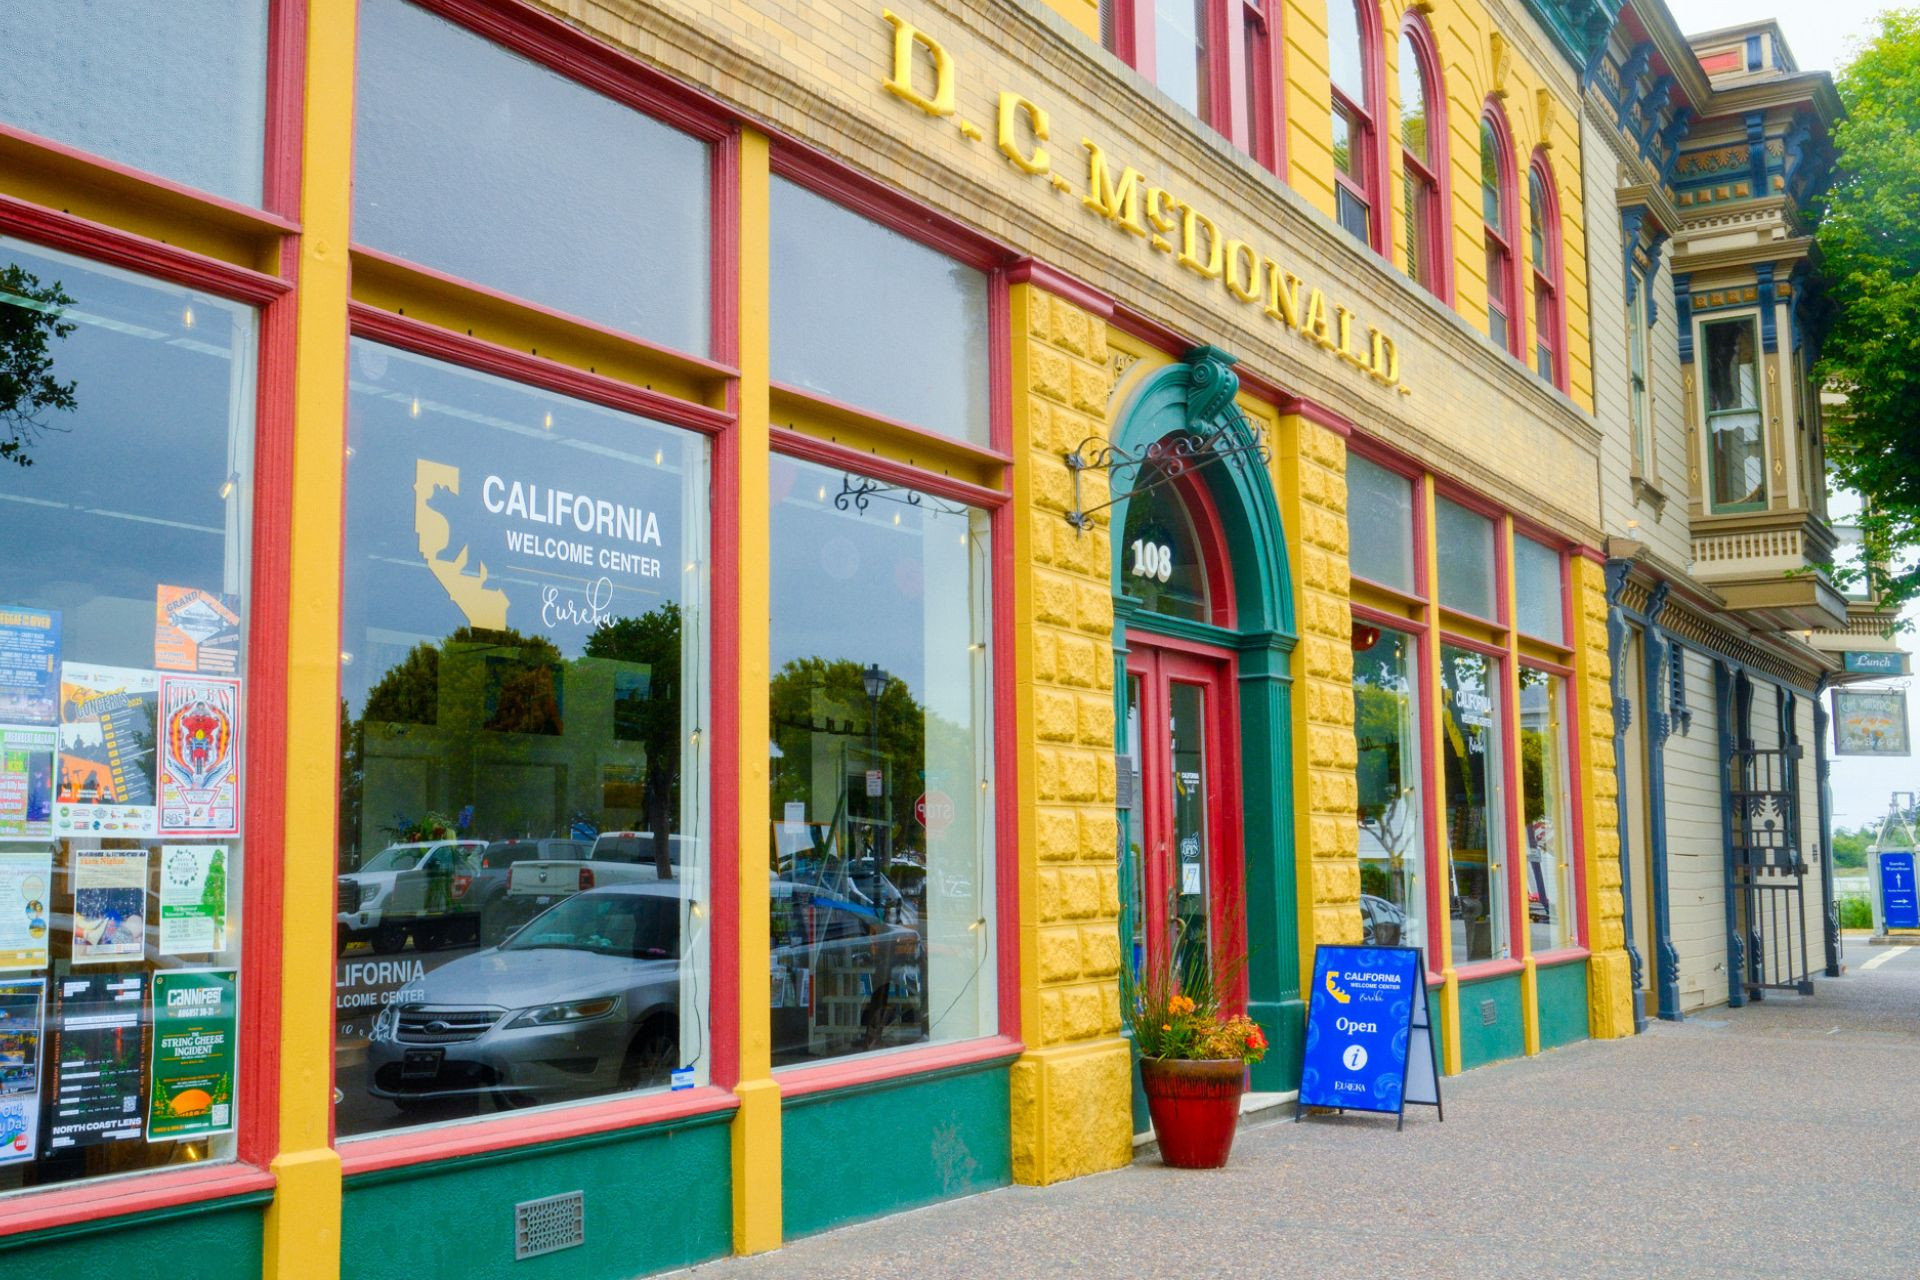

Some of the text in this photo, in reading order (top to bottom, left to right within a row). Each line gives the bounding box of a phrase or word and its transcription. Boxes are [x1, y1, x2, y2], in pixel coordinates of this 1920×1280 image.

[483, 474, 662, 547] CALIFORNIA
[506, 529, 661, 579] WELCOME CENTER
[1131, 538, 1172, 583] 108
[166, 591, 198, 612] GRAND
[541, 576, 618, 630] Eureka
[1856, 652, 1892, 668] Lunch
[335, 960, 425, 987] LIFORNIA
[1344, 972, 1401, 983] CALIFORNIA
[336, 989, 425, 1008] LCOME CENTER
[177, 1008, 198, 1018] AUGUST
[1335, 1016, 1378, 1035] Open
[161, 1034, 224, 1048] STRING CHEESE
[174, 1044, 213, 1057] INCIDENT
[1334, 1080, 1366, 1092] EUREKA
[53, 1123, 86, 1135] NORTH
[86, 1119, 117, 1131] COAST
[117, 1117, 142, 1127] LENS
